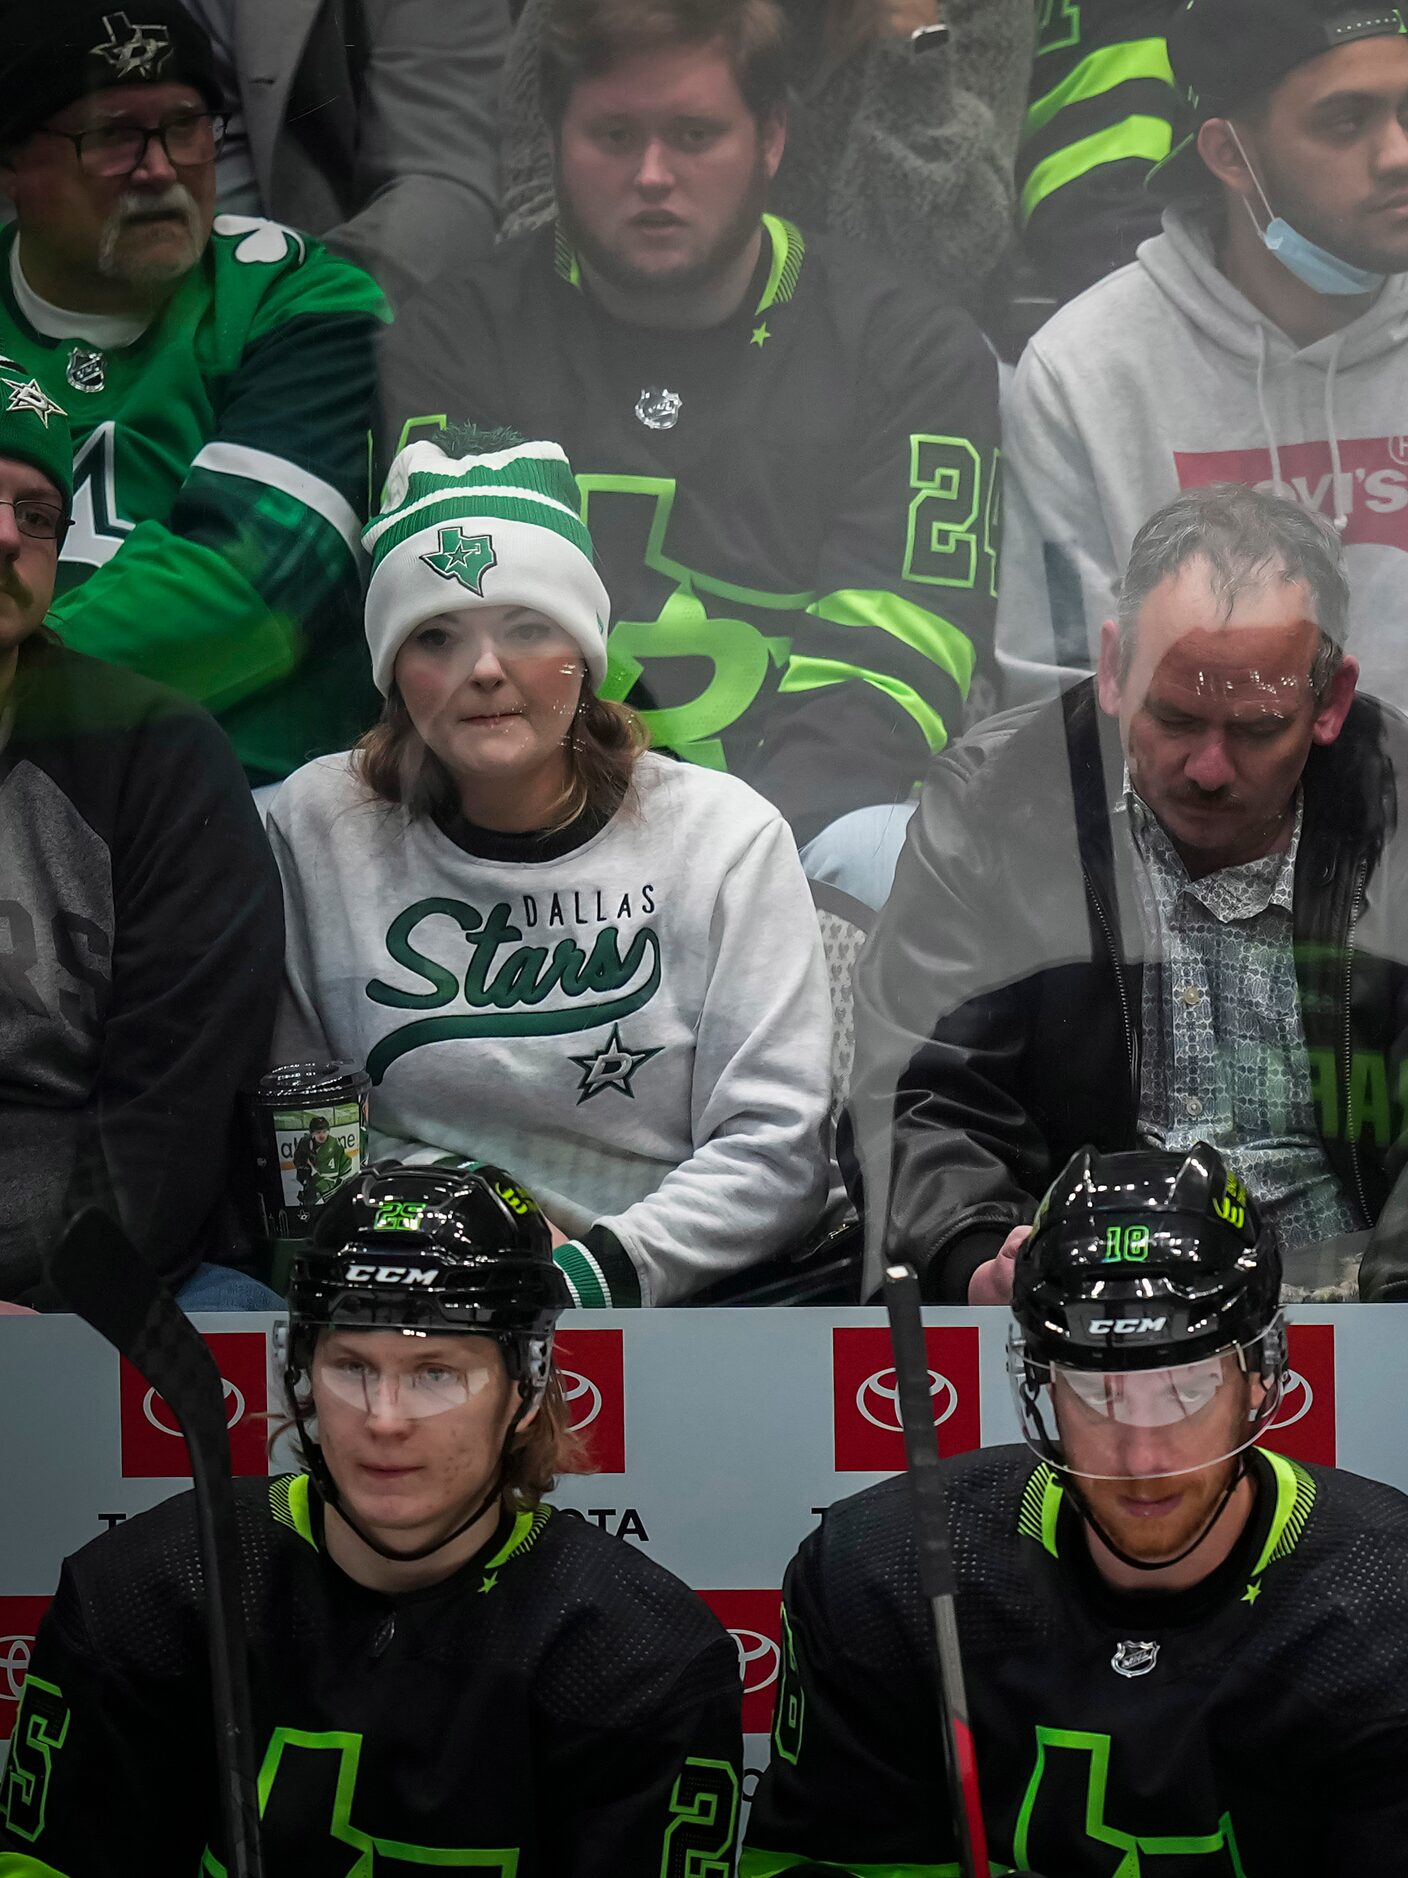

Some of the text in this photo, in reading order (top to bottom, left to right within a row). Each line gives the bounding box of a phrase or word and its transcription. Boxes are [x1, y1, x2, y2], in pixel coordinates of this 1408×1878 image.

[522, 884, 656, 928] DALLAS
[366, 896, 662, 1014] Stars
[344, 1264, 440, 1286] CCM
[1088, 1316, 1167, 1335] CCM
